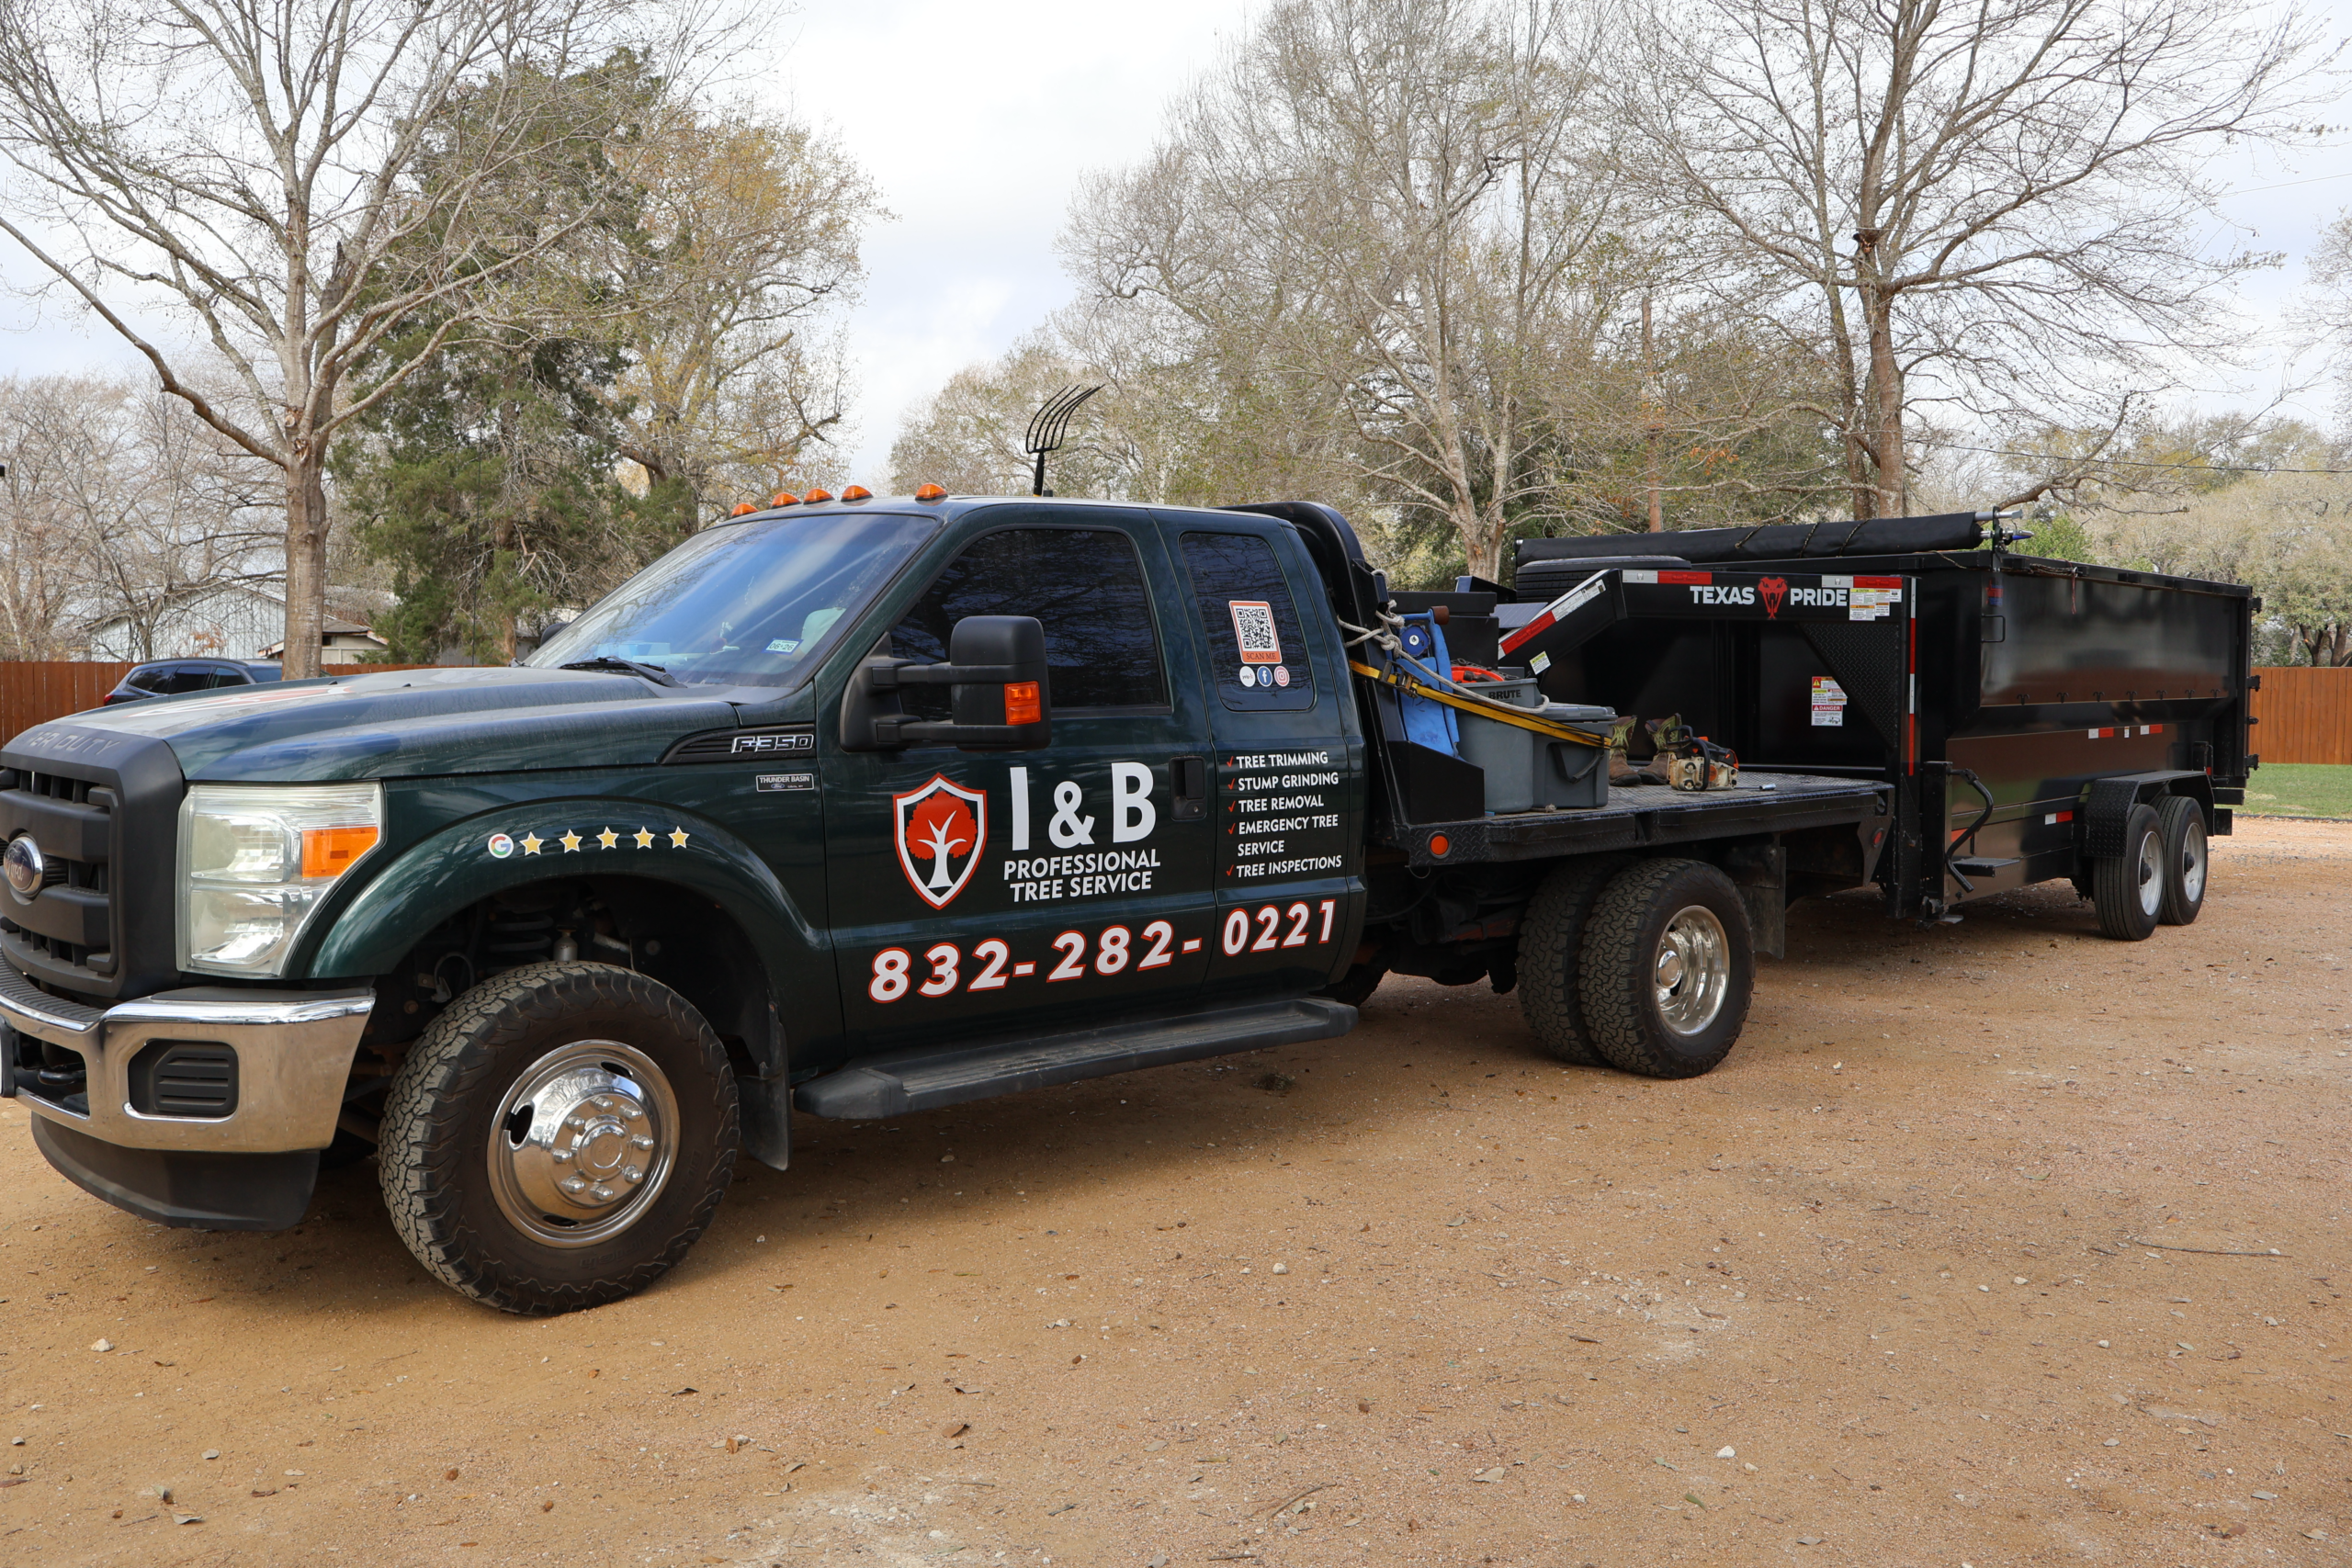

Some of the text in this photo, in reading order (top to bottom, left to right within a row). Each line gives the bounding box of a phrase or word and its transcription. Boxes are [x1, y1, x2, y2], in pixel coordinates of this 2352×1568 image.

[1690, 585, 1755, 605] TEXAS
[1790, 588, 1848, 606] PRIDE
[1488, 689, 1521, 699] BRUTE
[50, 734, 120, 755] DUTY
[731, 734, 814, 753] F-350
[1236, 751, 1329, 770] TREE TRIMMING
[1238, 772, 1339, 792] STUMP GRINDING
[1010, 761, 1157, 851] I & B
[1238, 795, 1325, 813] TREE REMOVAL
[1238, 814, 1339, 835] EMERGENCY TREE
[1238, 840, 1285, 857] SERVICE
[1003, 849, 1161, 881] PROFESSIONAL
[1236, 854, 1342, 878] TREE INSPECTIONS
[1010, 871, 1152, 902] TREE SERVICE
